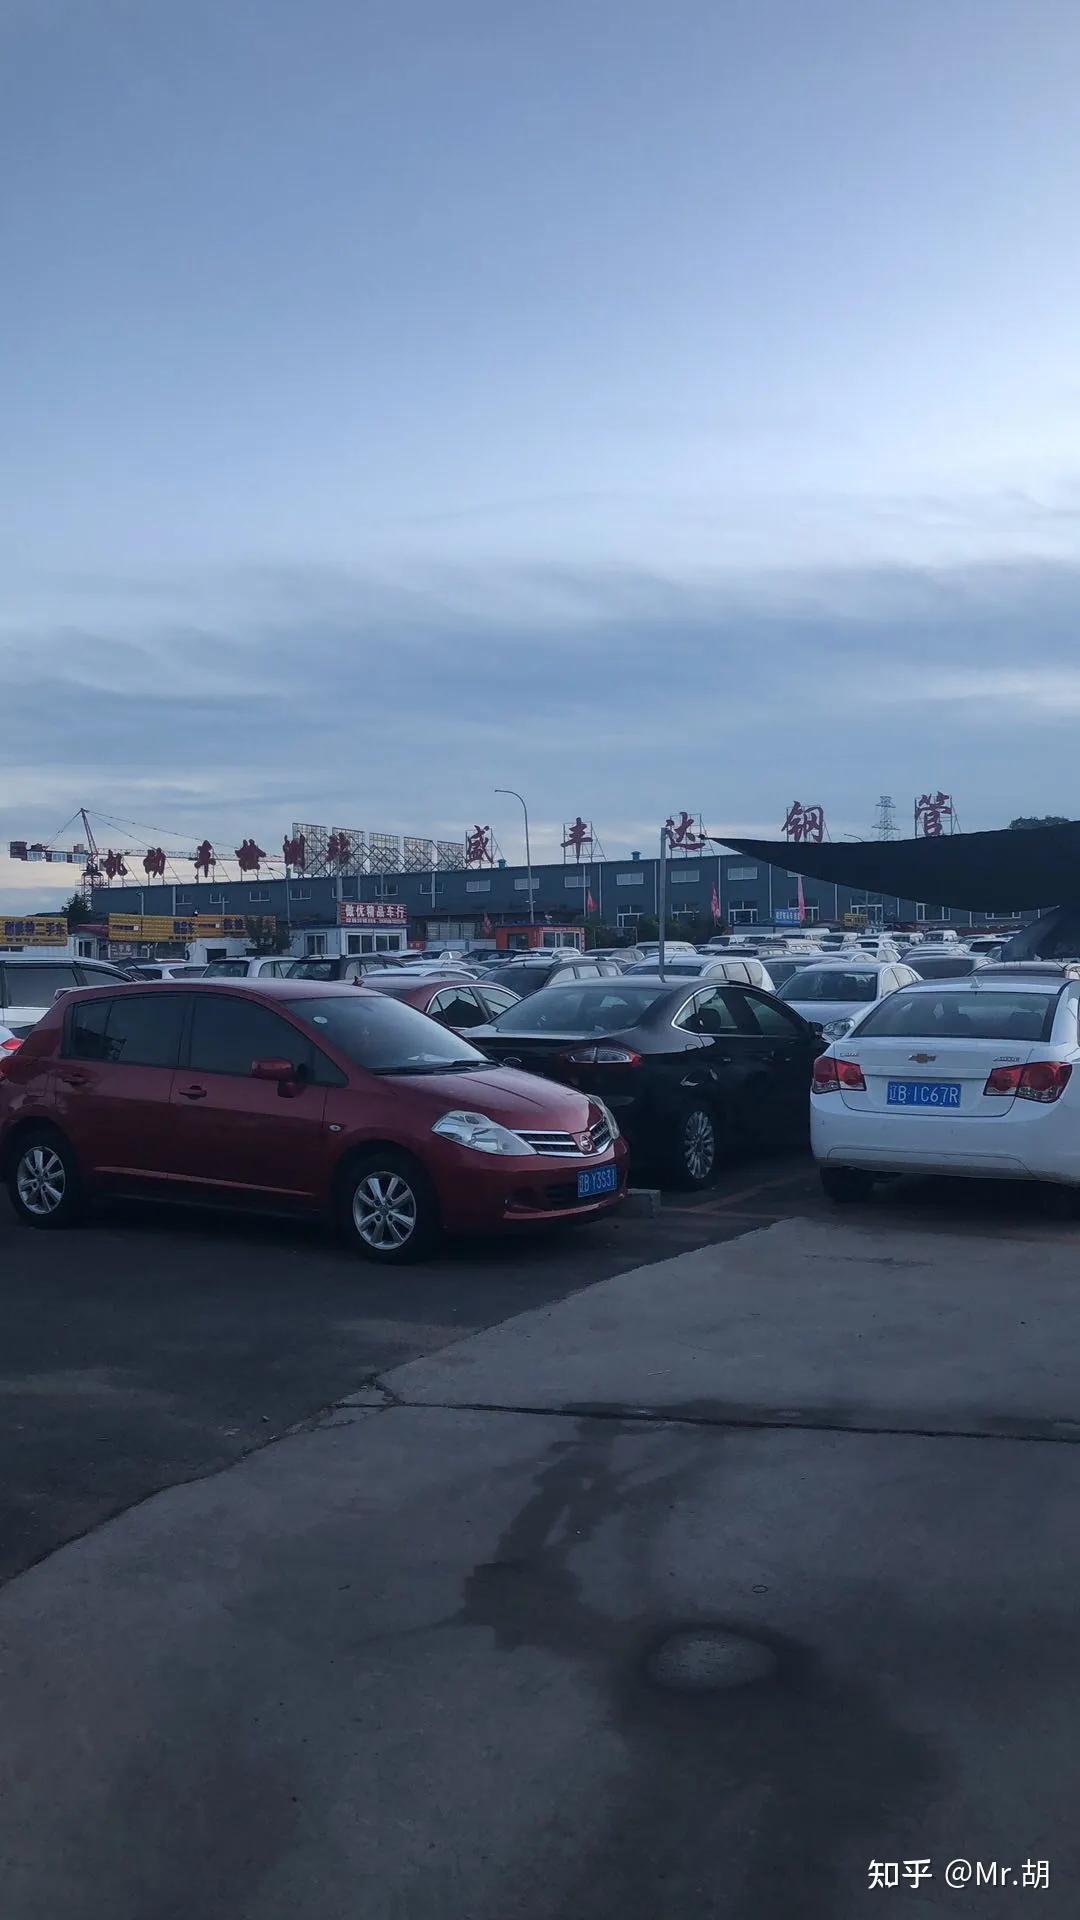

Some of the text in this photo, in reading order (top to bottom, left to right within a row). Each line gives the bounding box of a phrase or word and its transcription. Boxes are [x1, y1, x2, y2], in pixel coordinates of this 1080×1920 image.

[466, 791, 953, 865] 盛丰达钢管
